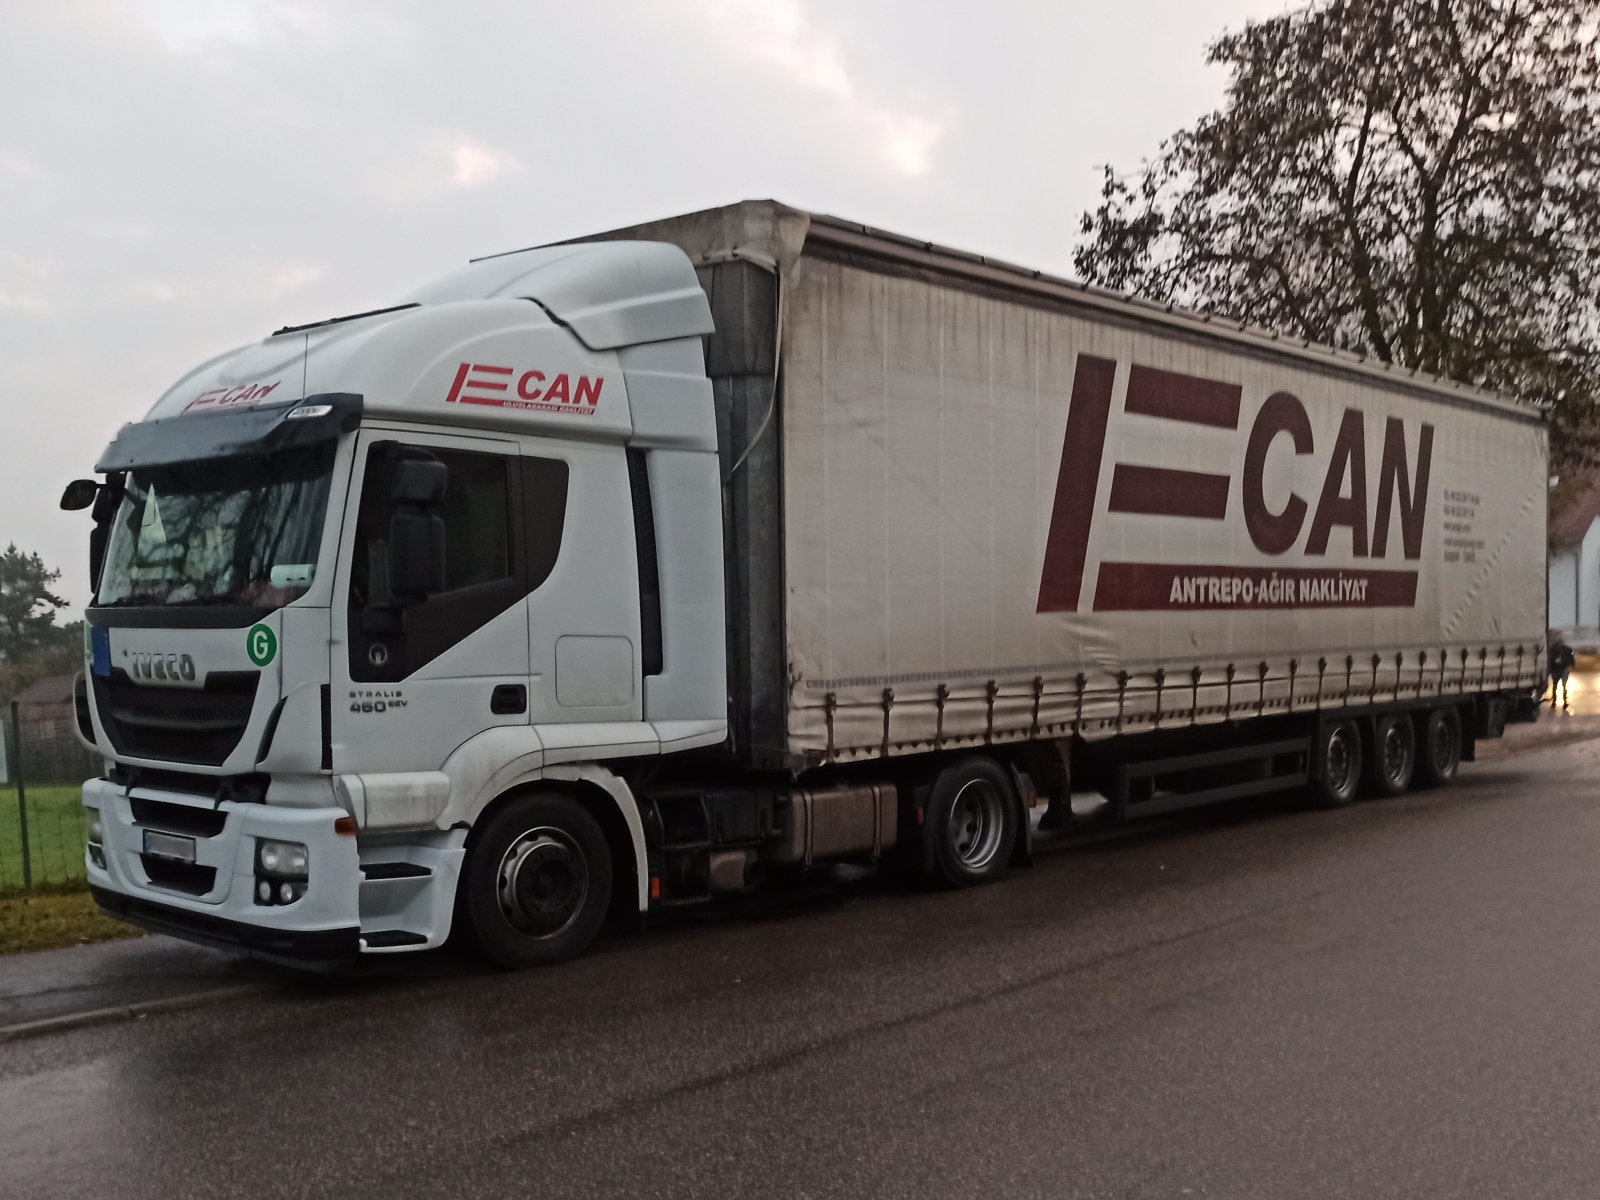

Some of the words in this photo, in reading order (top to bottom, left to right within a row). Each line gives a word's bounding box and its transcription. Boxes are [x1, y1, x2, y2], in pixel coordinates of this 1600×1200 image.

[1299, 572, 1368, 602] NAKLİYAT
[253, 631, 269, 660] G
[131, 652, 196, 681] IVECO
[349, 690, 403, 699] STRALIS
